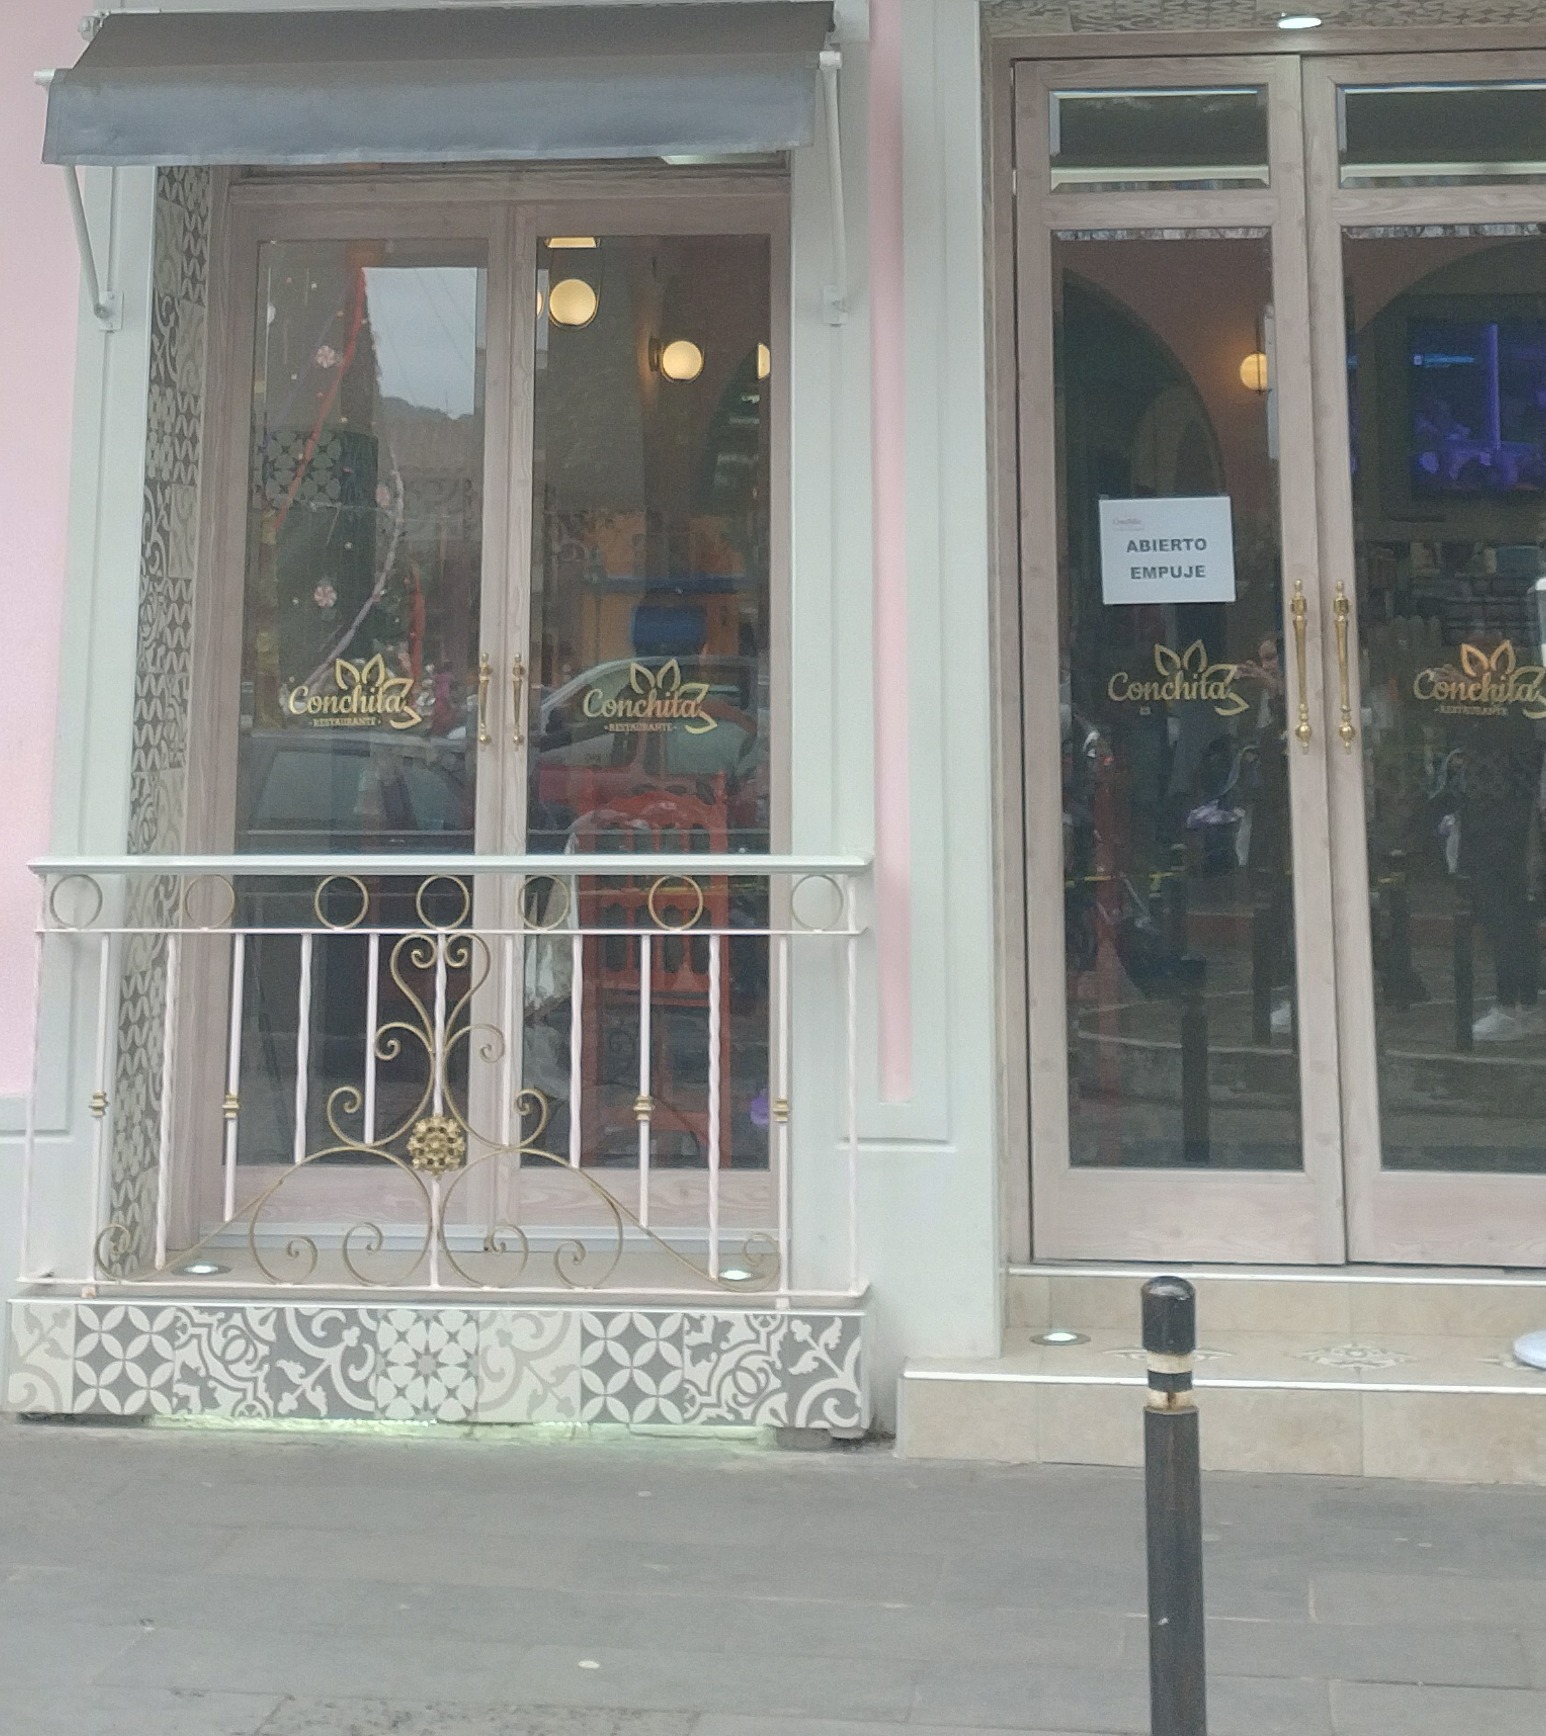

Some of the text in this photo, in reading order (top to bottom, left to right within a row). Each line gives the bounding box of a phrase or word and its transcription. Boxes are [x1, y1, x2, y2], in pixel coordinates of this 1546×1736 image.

[1126, 538, 1208, 553] ABIERTO
[1130, 565, 1206, 580] EMPUJE
[1108, 670, 1230, 702] Conchita
[1413, 669, 1541, 702] Conchita
[289, 685, 405, 714] Conchita
[583, 688, 701, 717] Conchita
[313, 717, 376, 727] RESTAURANTE
[609, 722, 673, 733] RESTAURANTE
